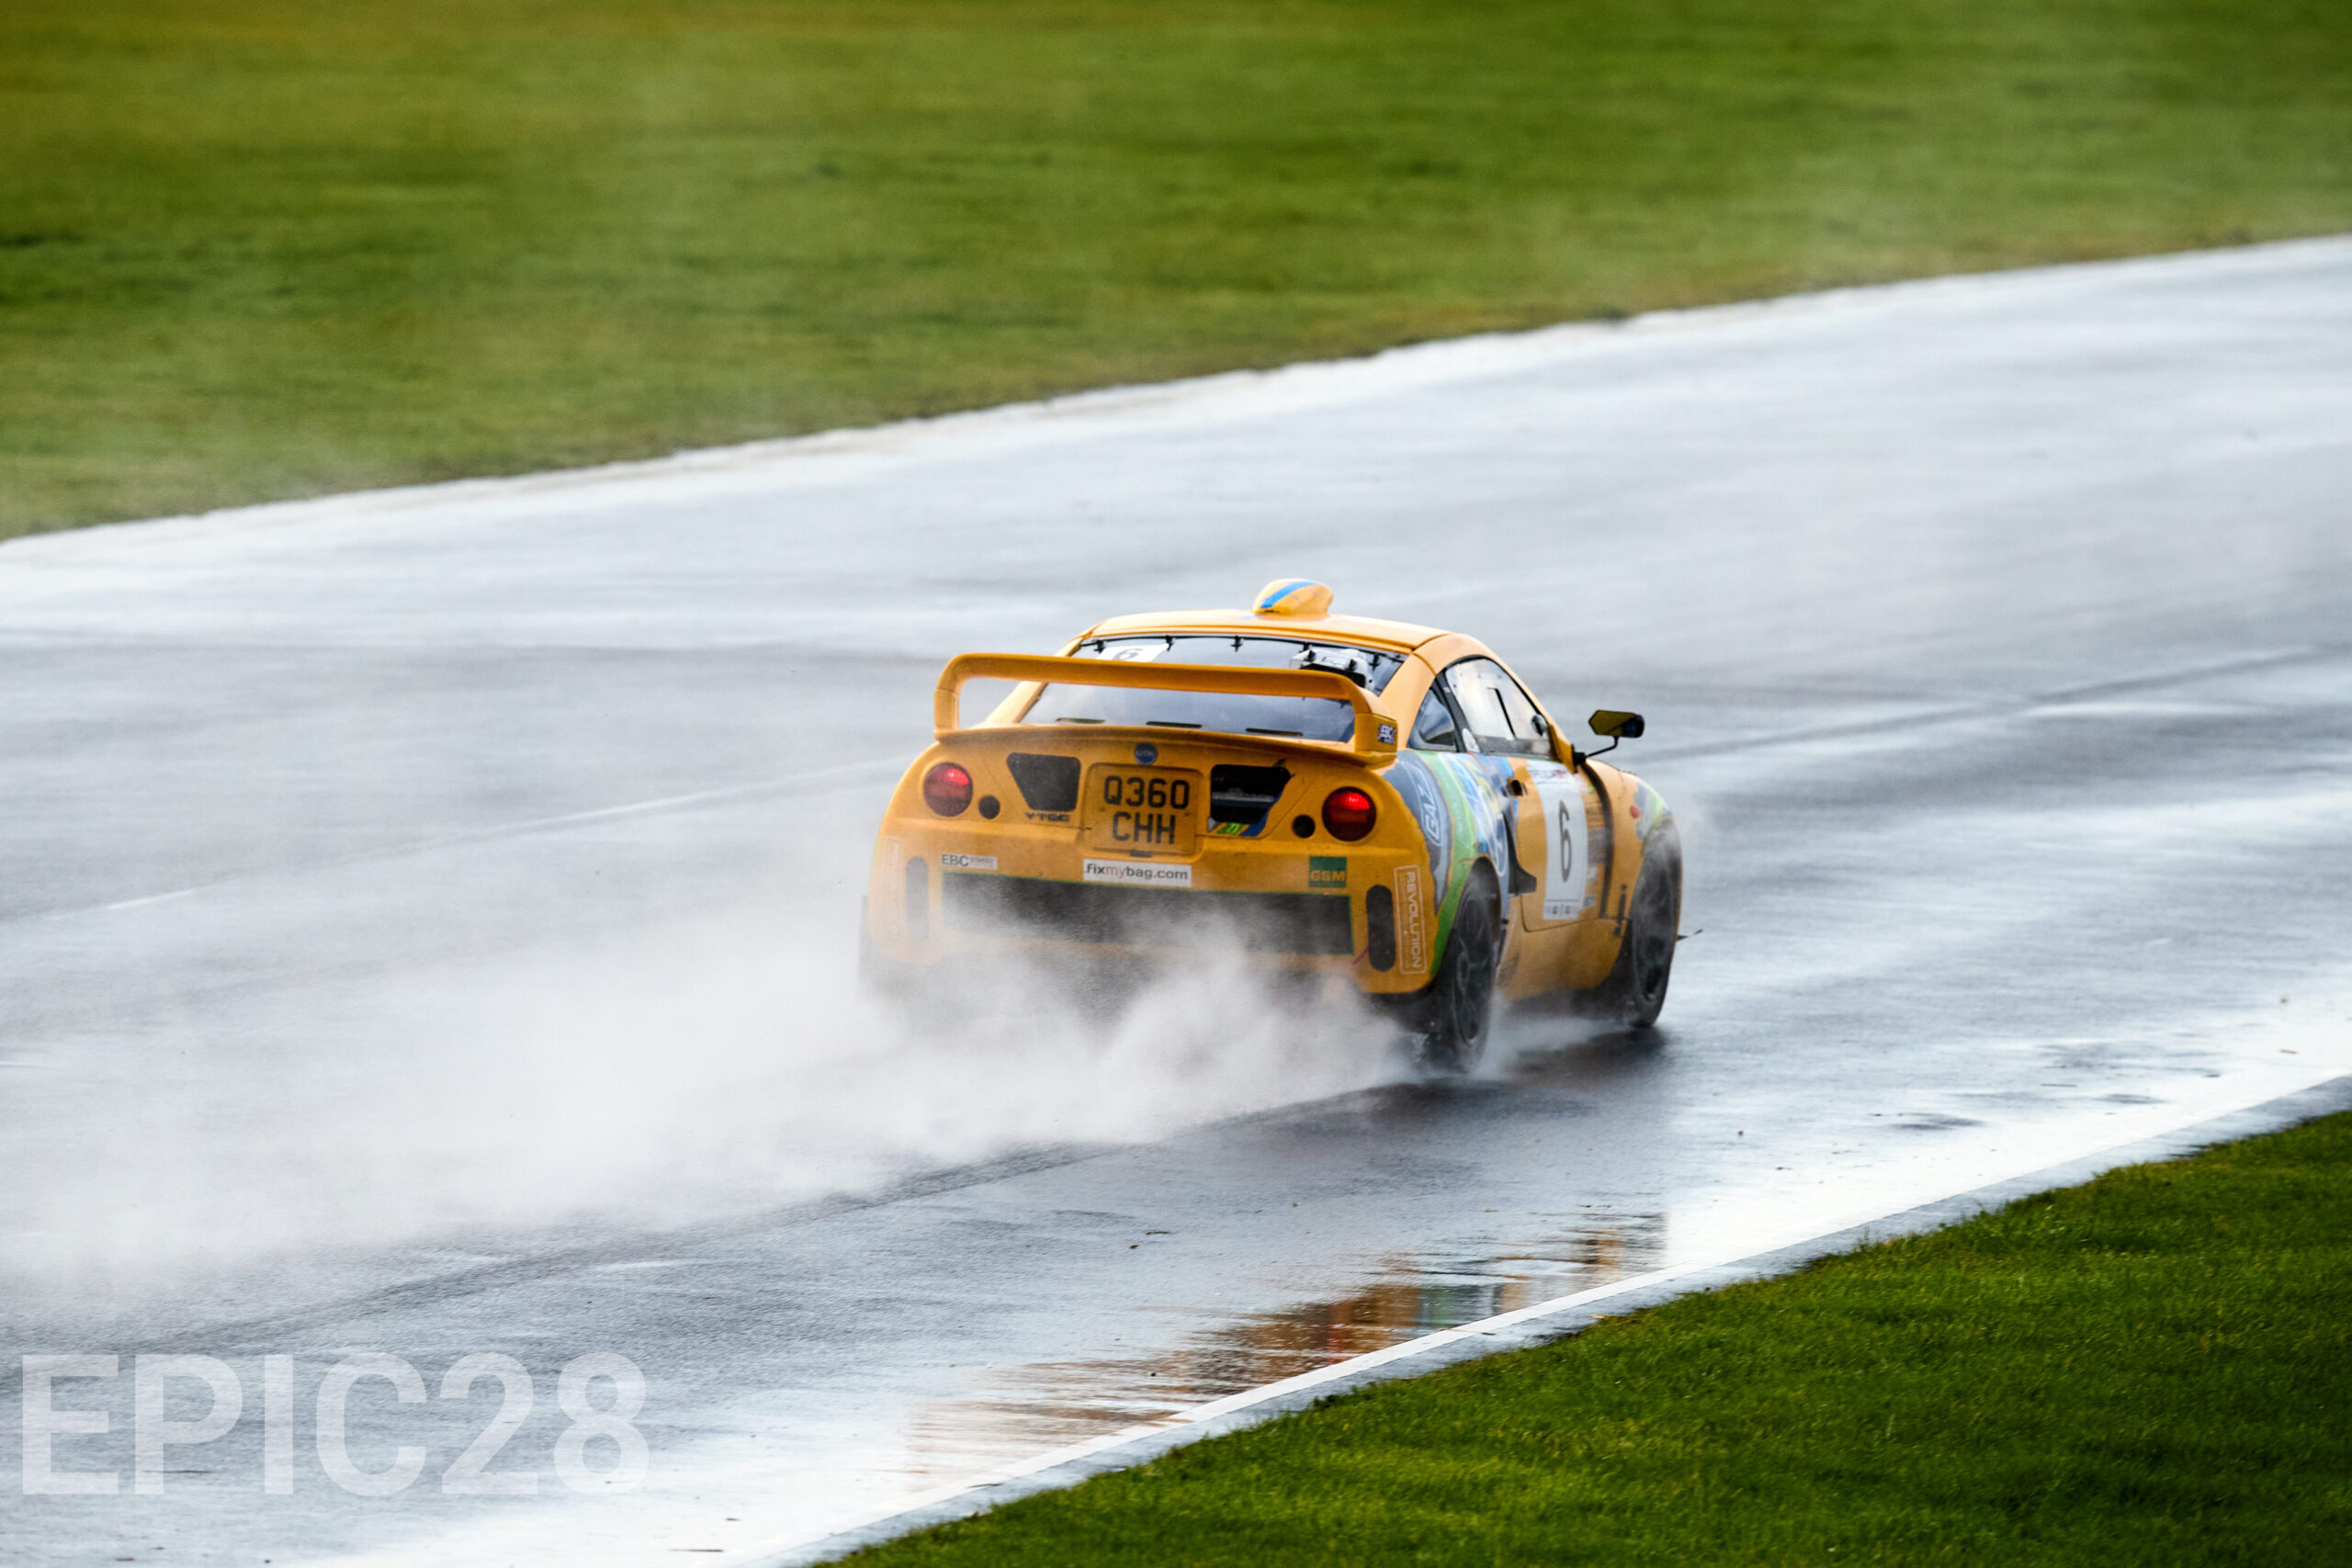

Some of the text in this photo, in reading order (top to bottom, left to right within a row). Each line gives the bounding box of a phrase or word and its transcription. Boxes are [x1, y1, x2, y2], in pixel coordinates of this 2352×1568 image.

[1104, 775, 1189, 809] Q360
[1113, 812, 1175, 844] CHH
[1417, 784, 1439, 840] GAZ
[1559, 800, 1572, 882] 6
[941, 853, 969, 867] EBC
[1087, 863, 1188, 880] fixmybag.com
[1311, 870, 1346, 882] GSM
[1407, 871, 1421, 968] REVOLUTION
